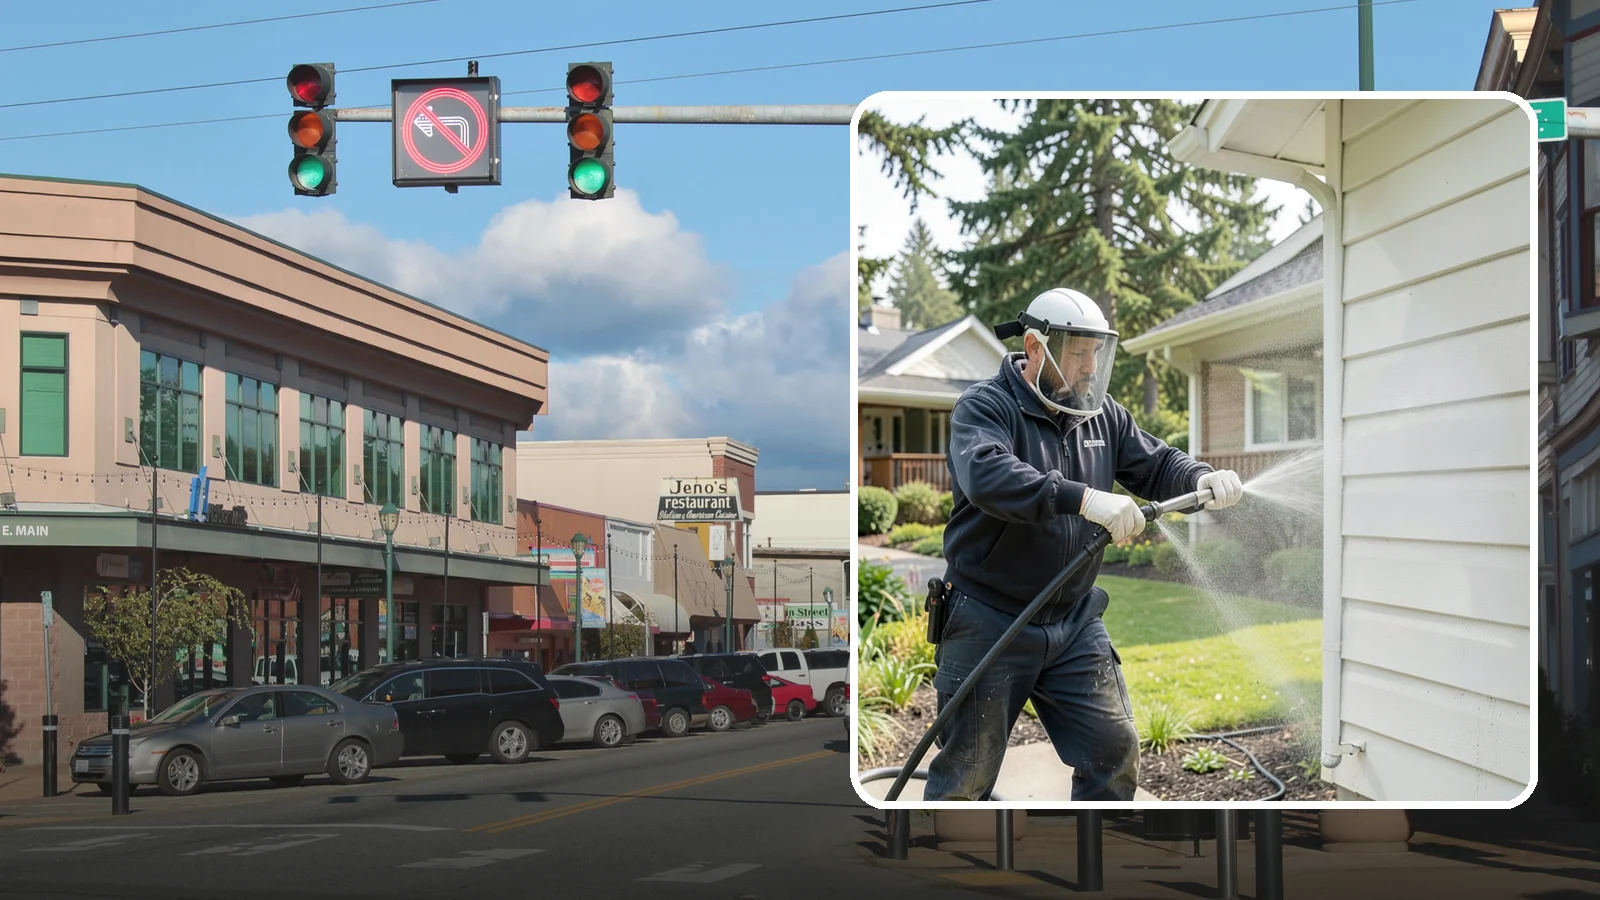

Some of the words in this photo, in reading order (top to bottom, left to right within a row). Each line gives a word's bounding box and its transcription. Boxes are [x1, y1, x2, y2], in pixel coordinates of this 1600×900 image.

[670, 480, 727, 494] Jeno's
[665, 496, 731, 508] restaurant
[658, 510, 681, 519] Italian
[686, 510, 714, 519] American
[714, 510, 737, 518] Cuisine
[2, 526, 12, 536] E.
[16, 526, 48, 536] MAIN
[797, 608, 828, 616] Street
